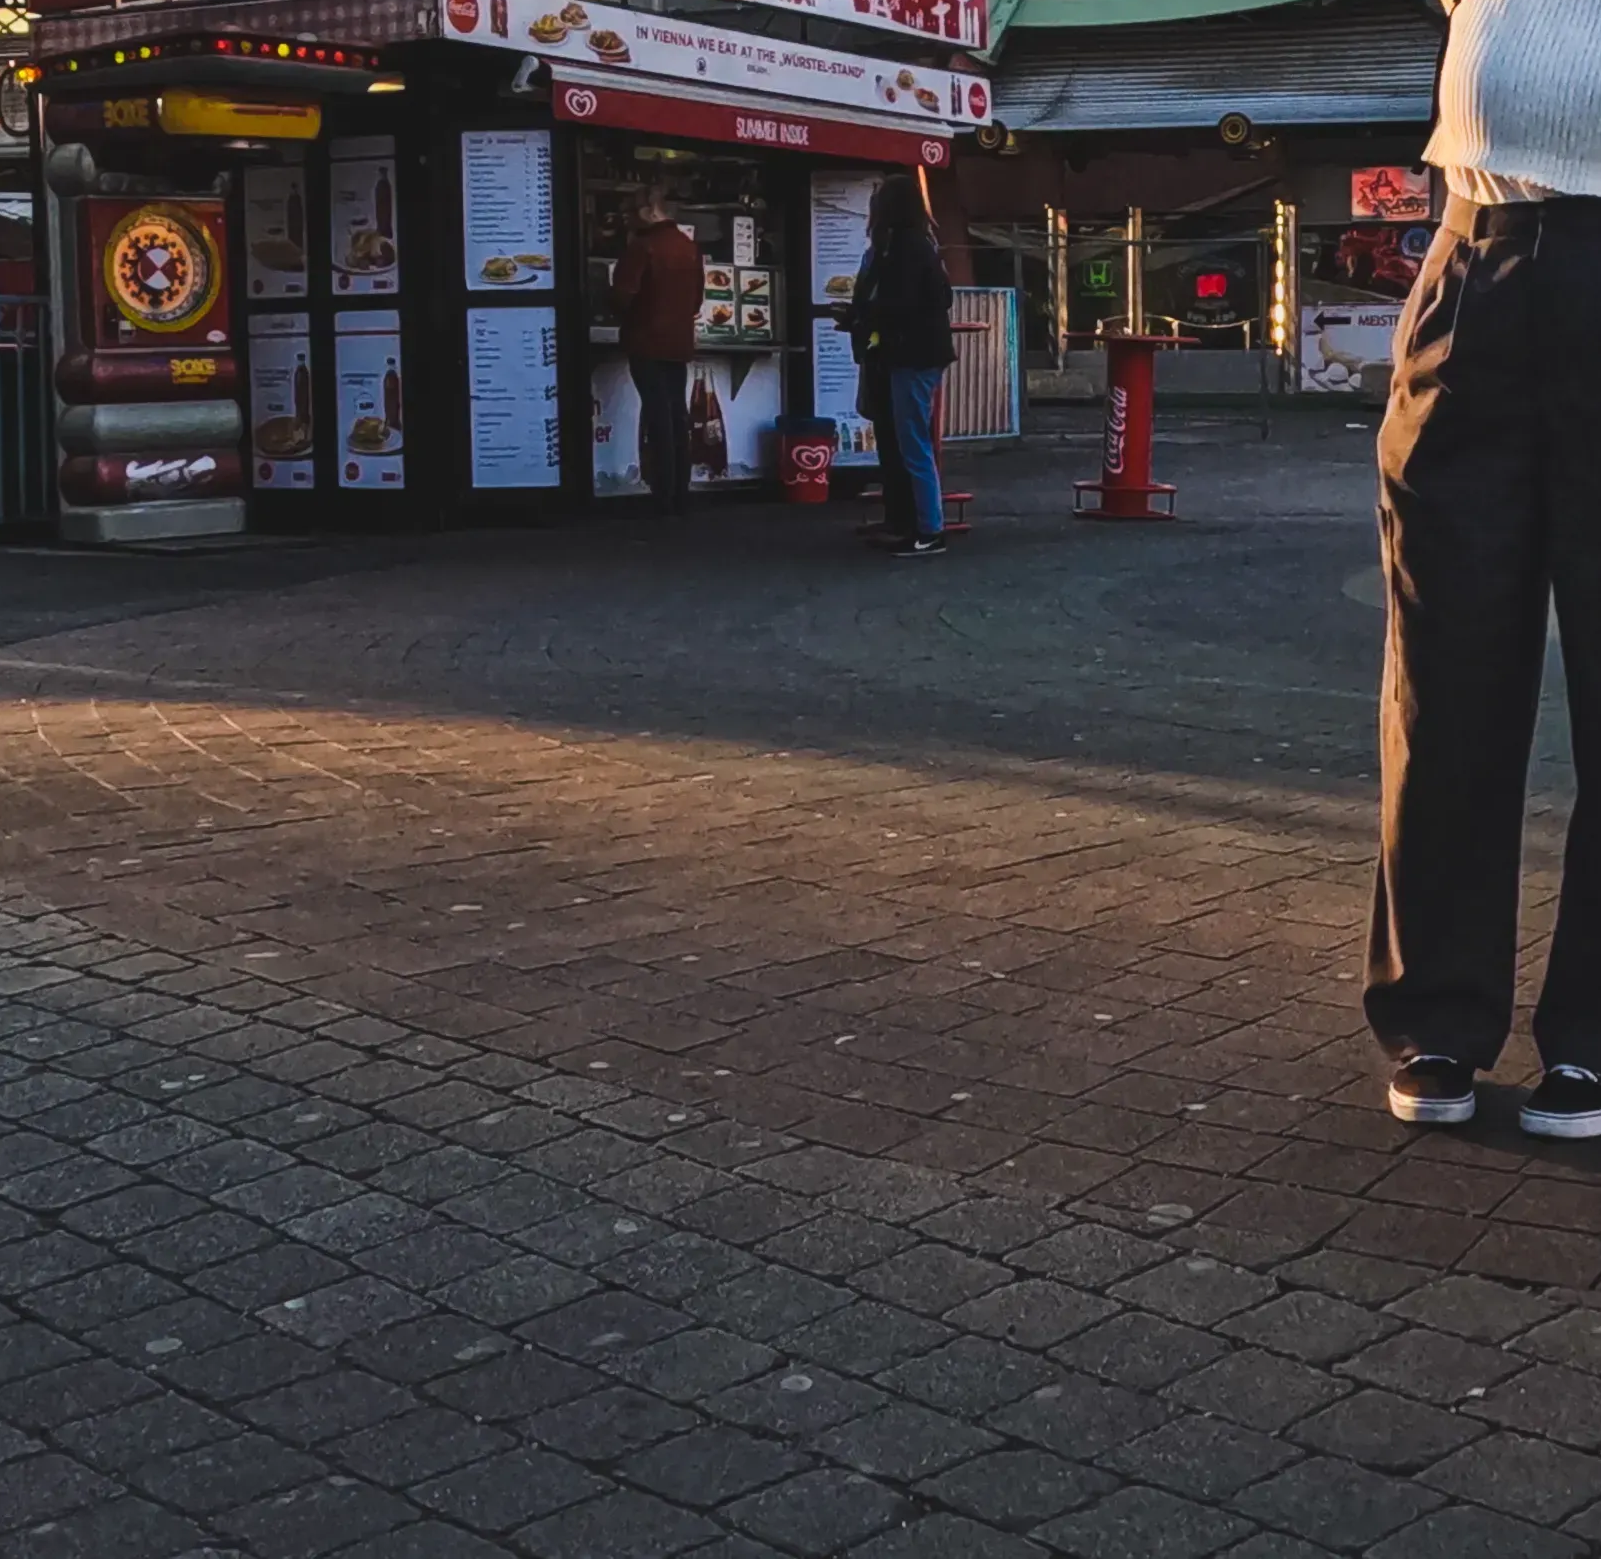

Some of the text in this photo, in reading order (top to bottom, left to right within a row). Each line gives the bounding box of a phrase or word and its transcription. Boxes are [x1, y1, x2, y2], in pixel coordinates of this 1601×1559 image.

[636, 25, 648, 40] IN
[651, 28, 694, 47] VIENNA
[697, 36, 715, 52] WE
[718, 40, 738, 56] EAT
[741, 45, 753, 59] AT
[756, 48, 777, 64] THE
[736, 117, 809, 146] SUMMER INSIDE
